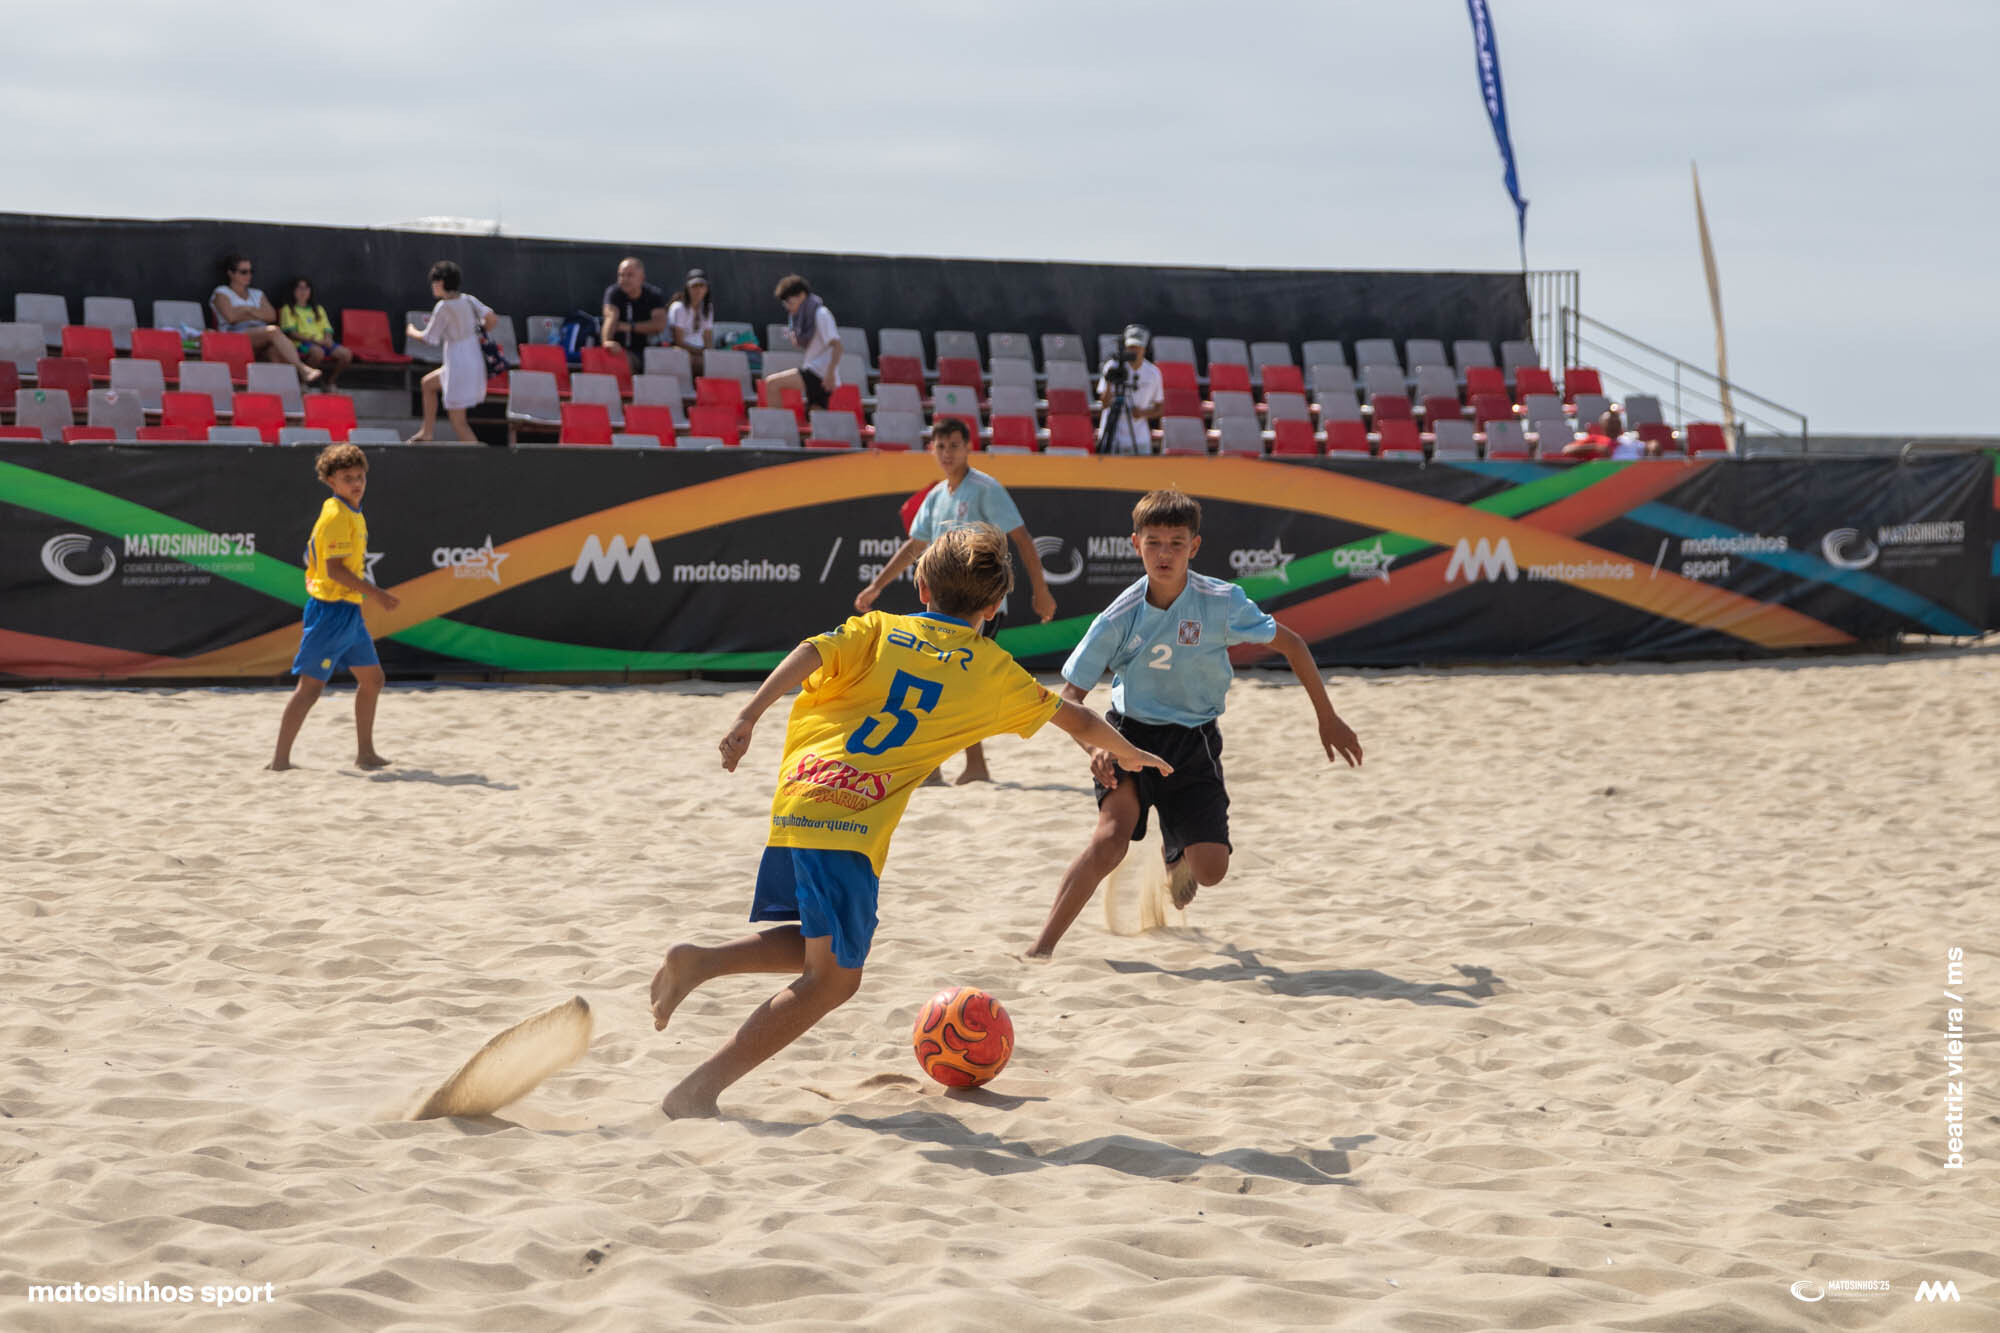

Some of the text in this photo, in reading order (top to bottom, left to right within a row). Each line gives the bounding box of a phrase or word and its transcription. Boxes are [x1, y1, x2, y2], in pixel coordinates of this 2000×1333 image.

[124, 533, 256, 557] MATOSINHOS'25
[1681, 533, 1788, 555] matosinhos
[673, 560, 800, 582] matosinhos
[1527, 560, 1635, 581] matosinhos
[1681, 557, 1730, 579] sport
[1149, 644, 1173, 670] 2
[845, 668, 944, 756] 5
